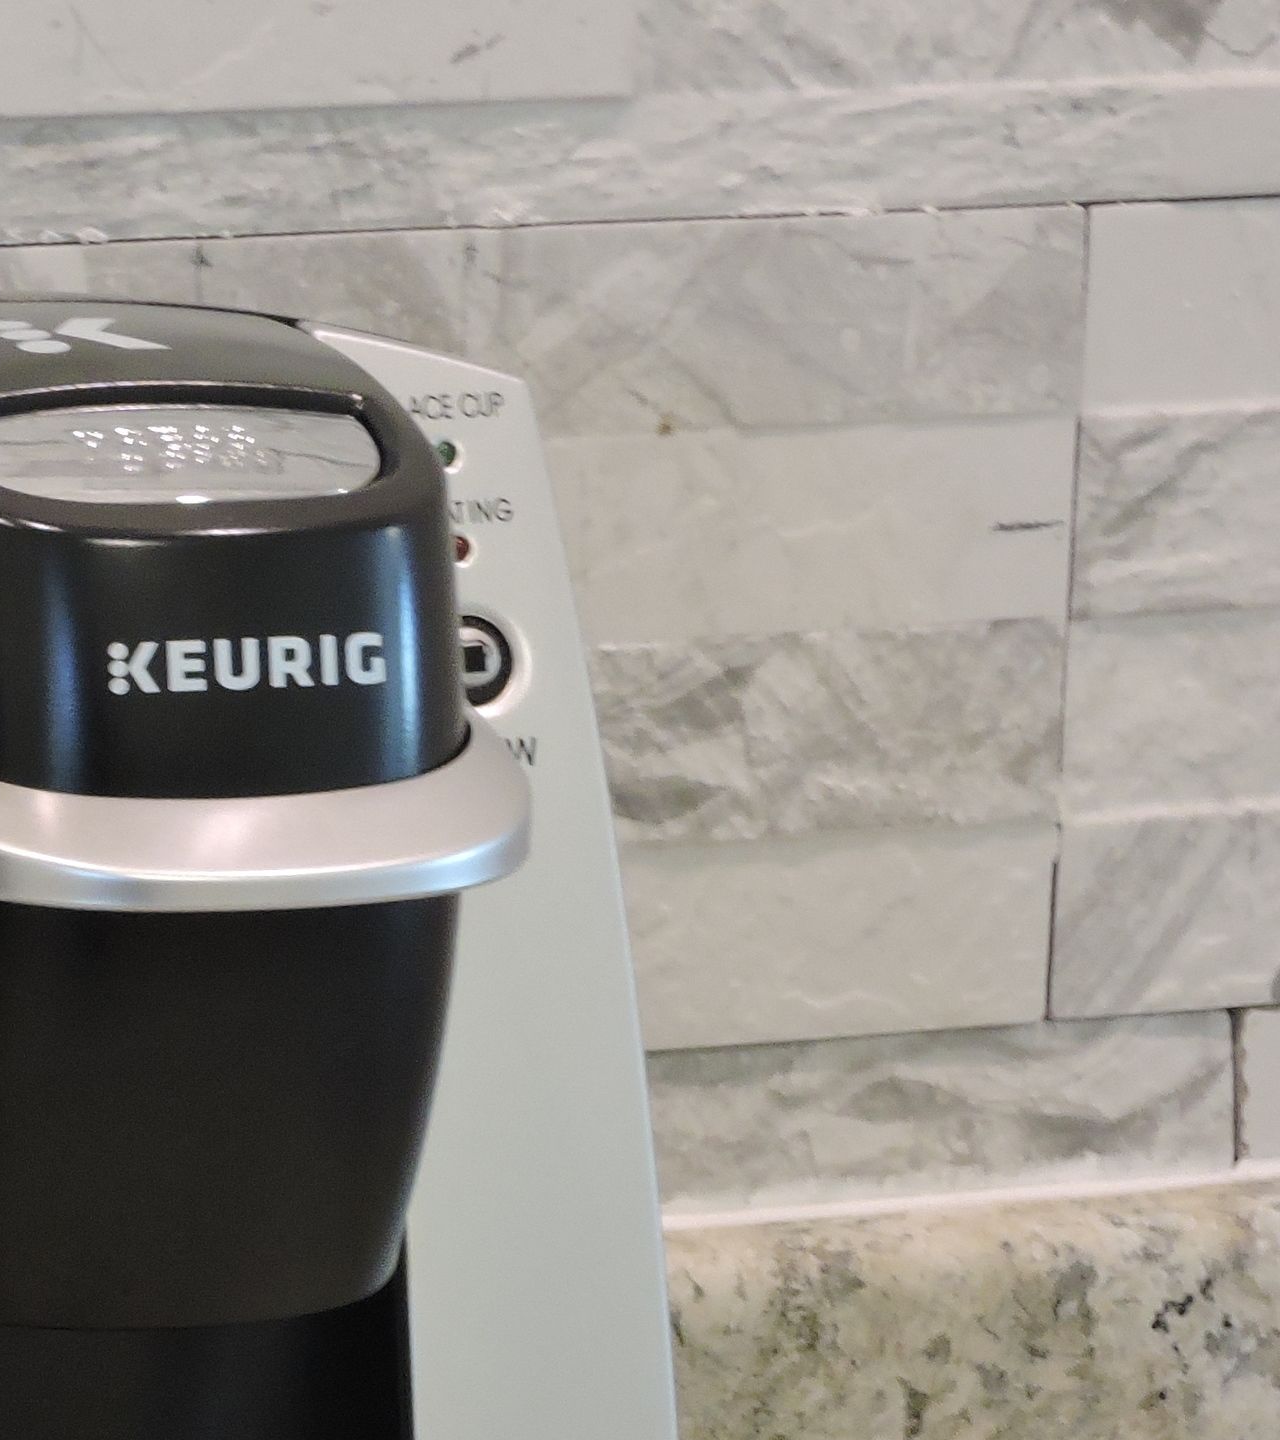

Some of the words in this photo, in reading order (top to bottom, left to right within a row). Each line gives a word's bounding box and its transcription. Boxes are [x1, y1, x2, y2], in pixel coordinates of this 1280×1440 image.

[409, 393, 453, 419] ACE
[458, 391, 504, 418] CUP
[450, 497, 514, 524] TING
[107, 632, 387, 695] KEURIG
